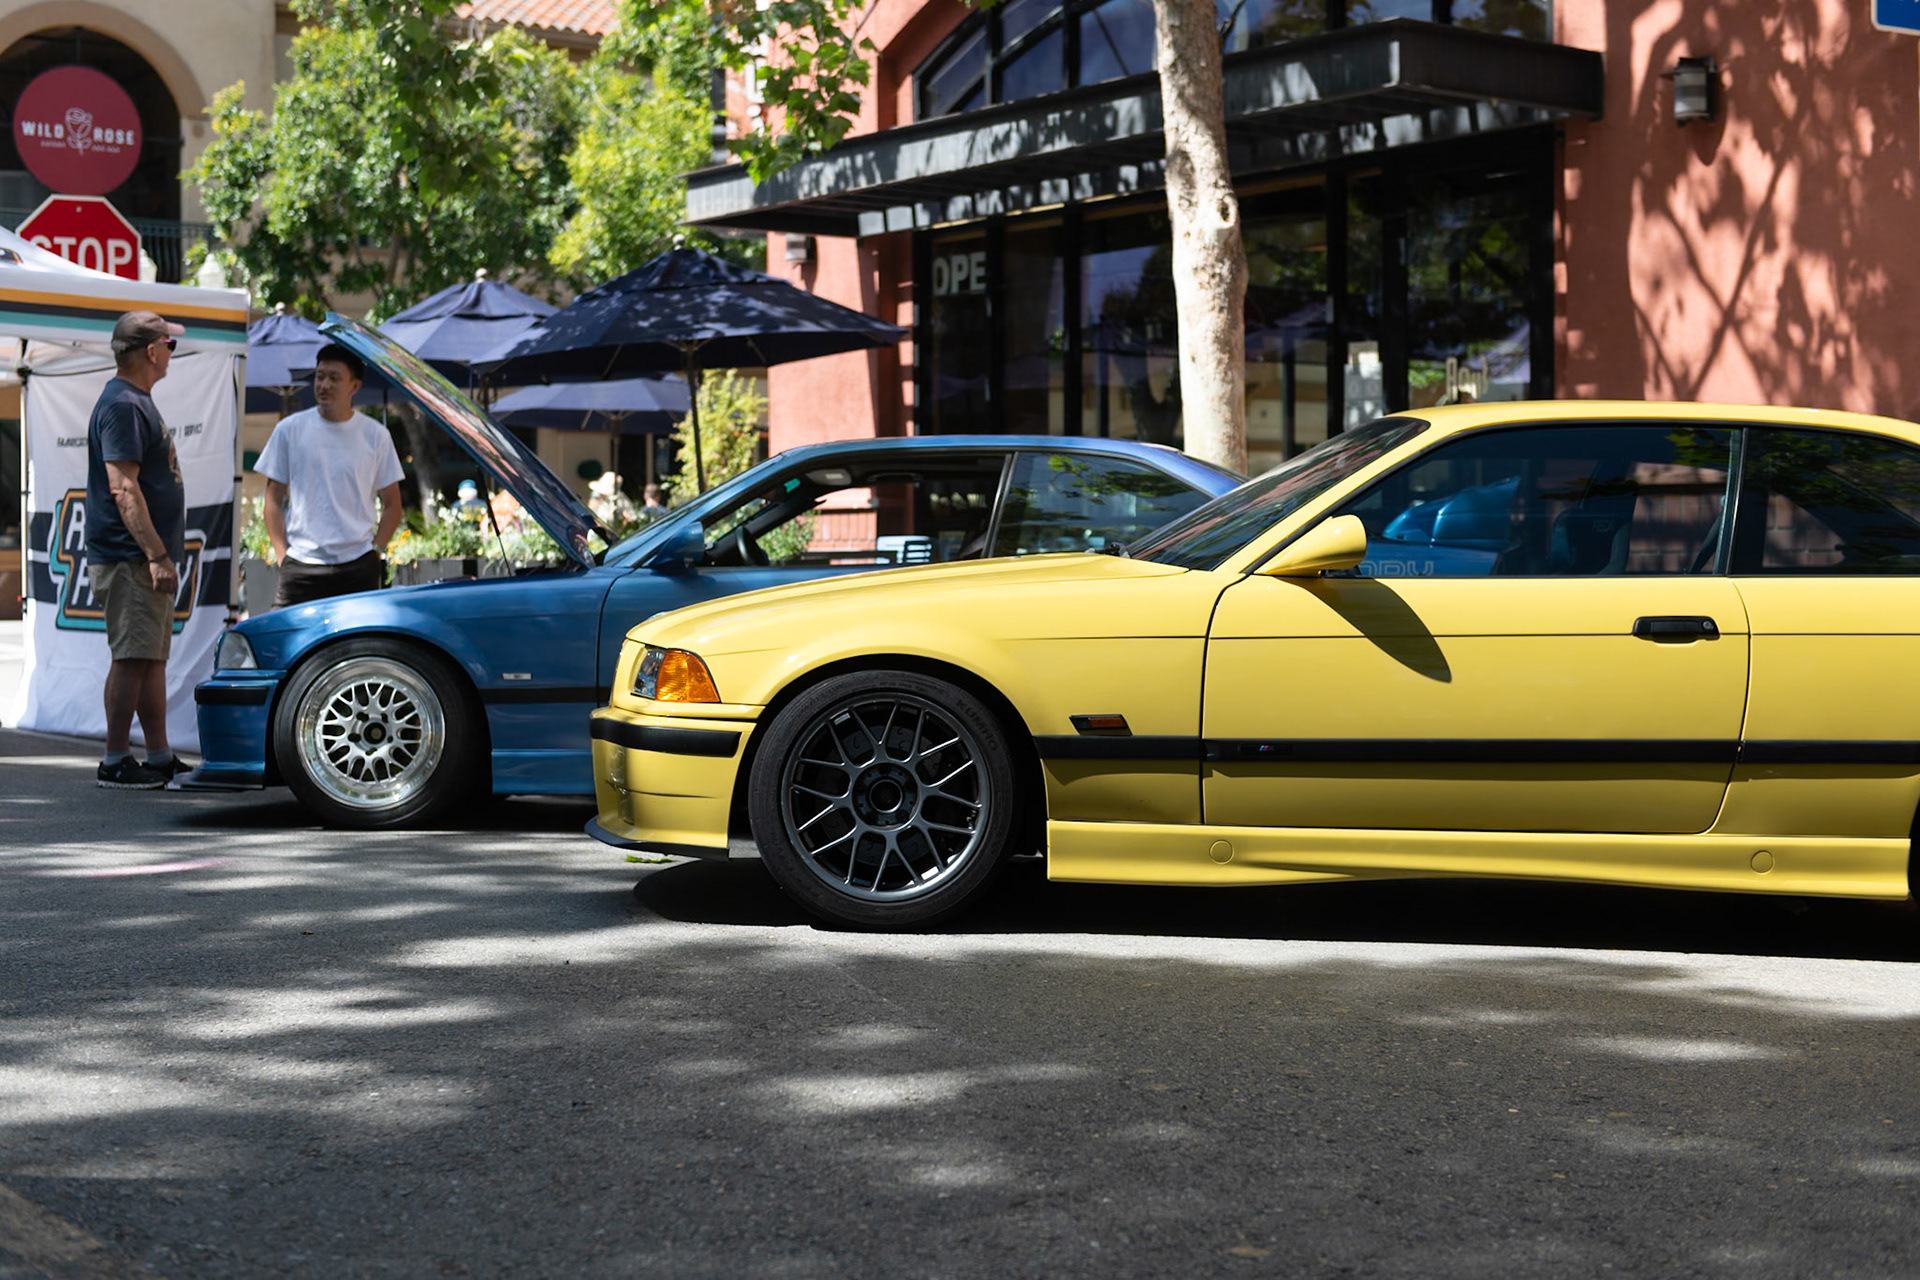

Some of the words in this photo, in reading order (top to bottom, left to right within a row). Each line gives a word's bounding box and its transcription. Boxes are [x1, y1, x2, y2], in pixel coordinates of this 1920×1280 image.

[21, 120, 65, 139] WILD
[93, 127, 135, 146] ROSE
[31, 235, 132, 275] TOP
[955, 699, 998, 751] KUMHO
